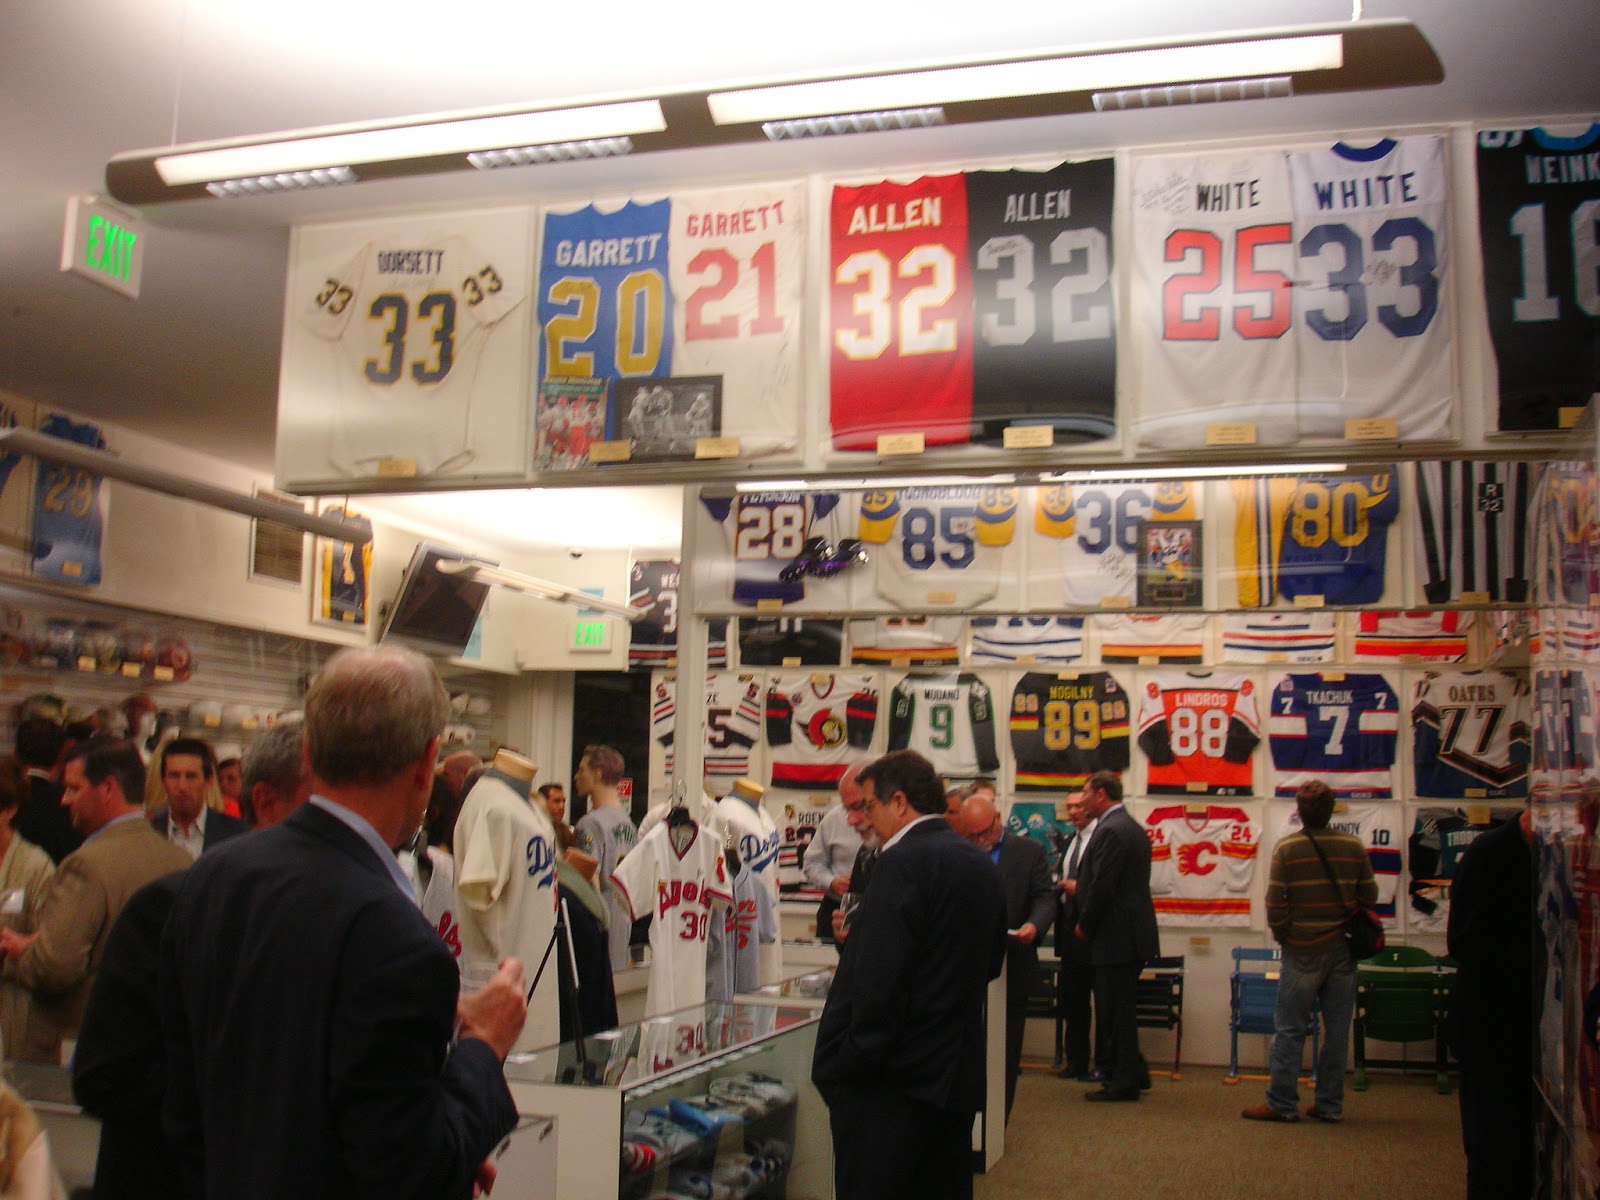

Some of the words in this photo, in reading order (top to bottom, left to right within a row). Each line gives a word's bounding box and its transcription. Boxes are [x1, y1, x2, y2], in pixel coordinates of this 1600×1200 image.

[1003, 188, 1072, 224] ALLEN
[1195, 178, 1261, 213] WHITE
[1313, 171, 1418, 211] WHITE
[685, 200, 785, 238] GARRETT
[847, 196, 942, 236] ALLEN
[85, 213, 137, 284] EXIT
[376, 250, 445, 276] DORSETT
[555, 232, 664, 269] GARRETT
[461, 264, 504, 307] 33
[684, 241, 785, 344] 21
[976, 226, 1112, 348] 32
[1162, 222, 1293, 341] 25
[1299, 216, 1439, 340] 33
[835, 243, 957, 361] 32
[362, 289, 457, 387] 33
[545, 267, 666, 378] 20
[1480, 499, 1500, 513] 32
[1485, 483, 1497, 497] R
[734, 504, 804, 561] 28
[1075, 489, 1151, 554] 36
[1292, 481, 1369, 547] 80
[902, 507, 975, 570] 85
[574, 622, 605, 647] EXIT
[924, 688, 960, 701] MODANO
[1049, 685, 1095, 701] MOGILNY
[1175, 692, 1228, 708] LINDROS
[1281, 697, 1294, 715] 7
[1306, 689, 1354, 705] TKACHUK
[1375, 692, 1388, 710] 7
[1450, 685, 1496, 702] OATES
[929, 703, 954, 750] 9
[1043, 699, 1101, 750] 89
[1169, 707, 1229, 758] 88
[1318, 705, 1350, 756] 7
[1438, 704, 1507, 756] 77
[1231, 825, 1252, 842] 24
[1372, 829, 1390, 846] 10
[680, 910, 708, 942] 30
